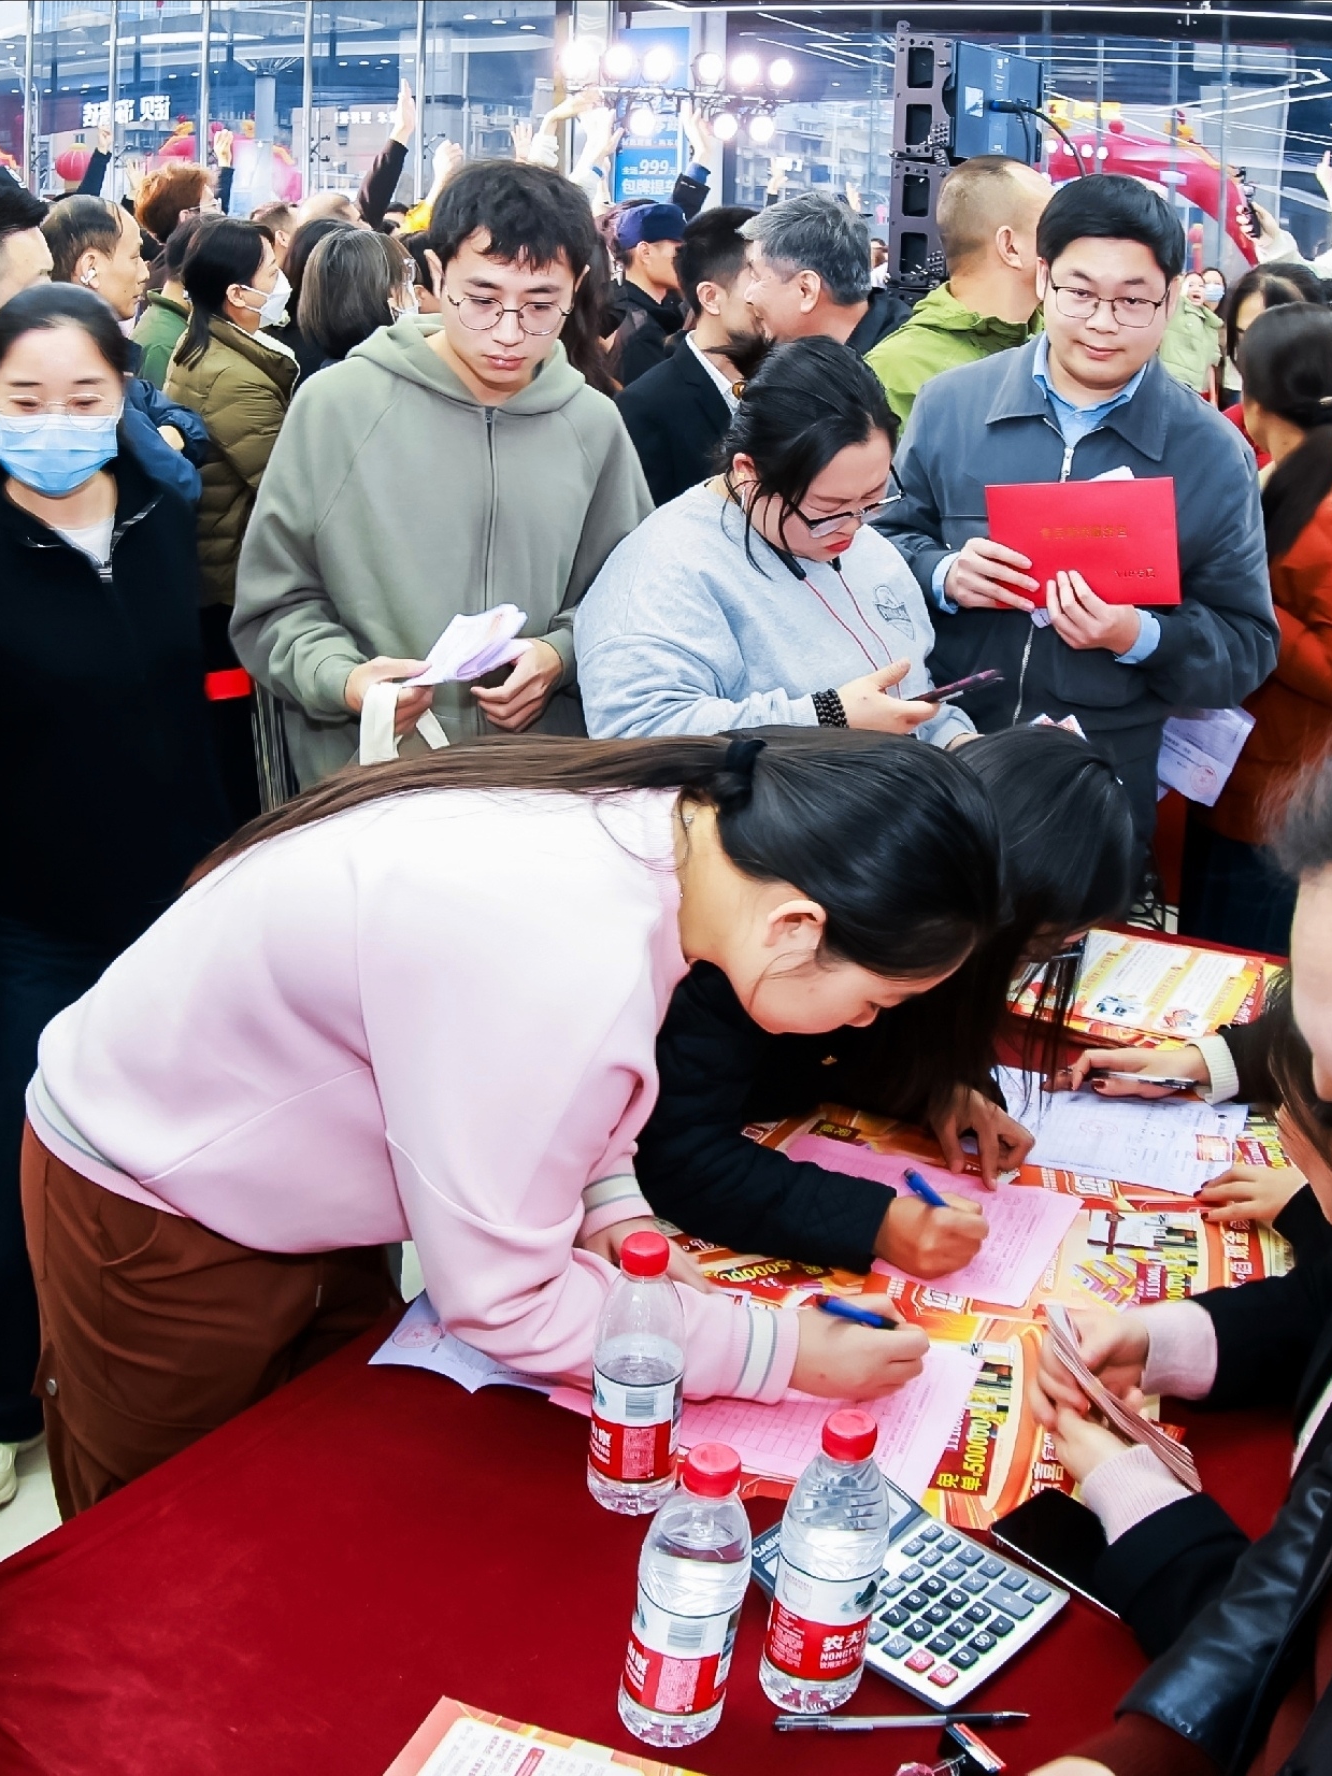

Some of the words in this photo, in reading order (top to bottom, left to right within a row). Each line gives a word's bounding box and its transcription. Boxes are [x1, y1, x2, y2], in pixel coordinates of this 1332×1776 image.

[928, 1579, 940, 1589] 9
[908, 1595, 921, 1604] 8
[950, 1593, 963, 1603] 6
[889, 1609, 901, 1620] 7
[932, 1607, 944, 1617] 5
[972, 1606, 985, 1617] 3
[913, 1623, 925, 1634] 4
[954, 1622, 967, 1632] 2
[936, 1637, 947, 1646] 1
[974, 1635, 991, 1647] 00
[957, 1652, 969, 1662] 0
